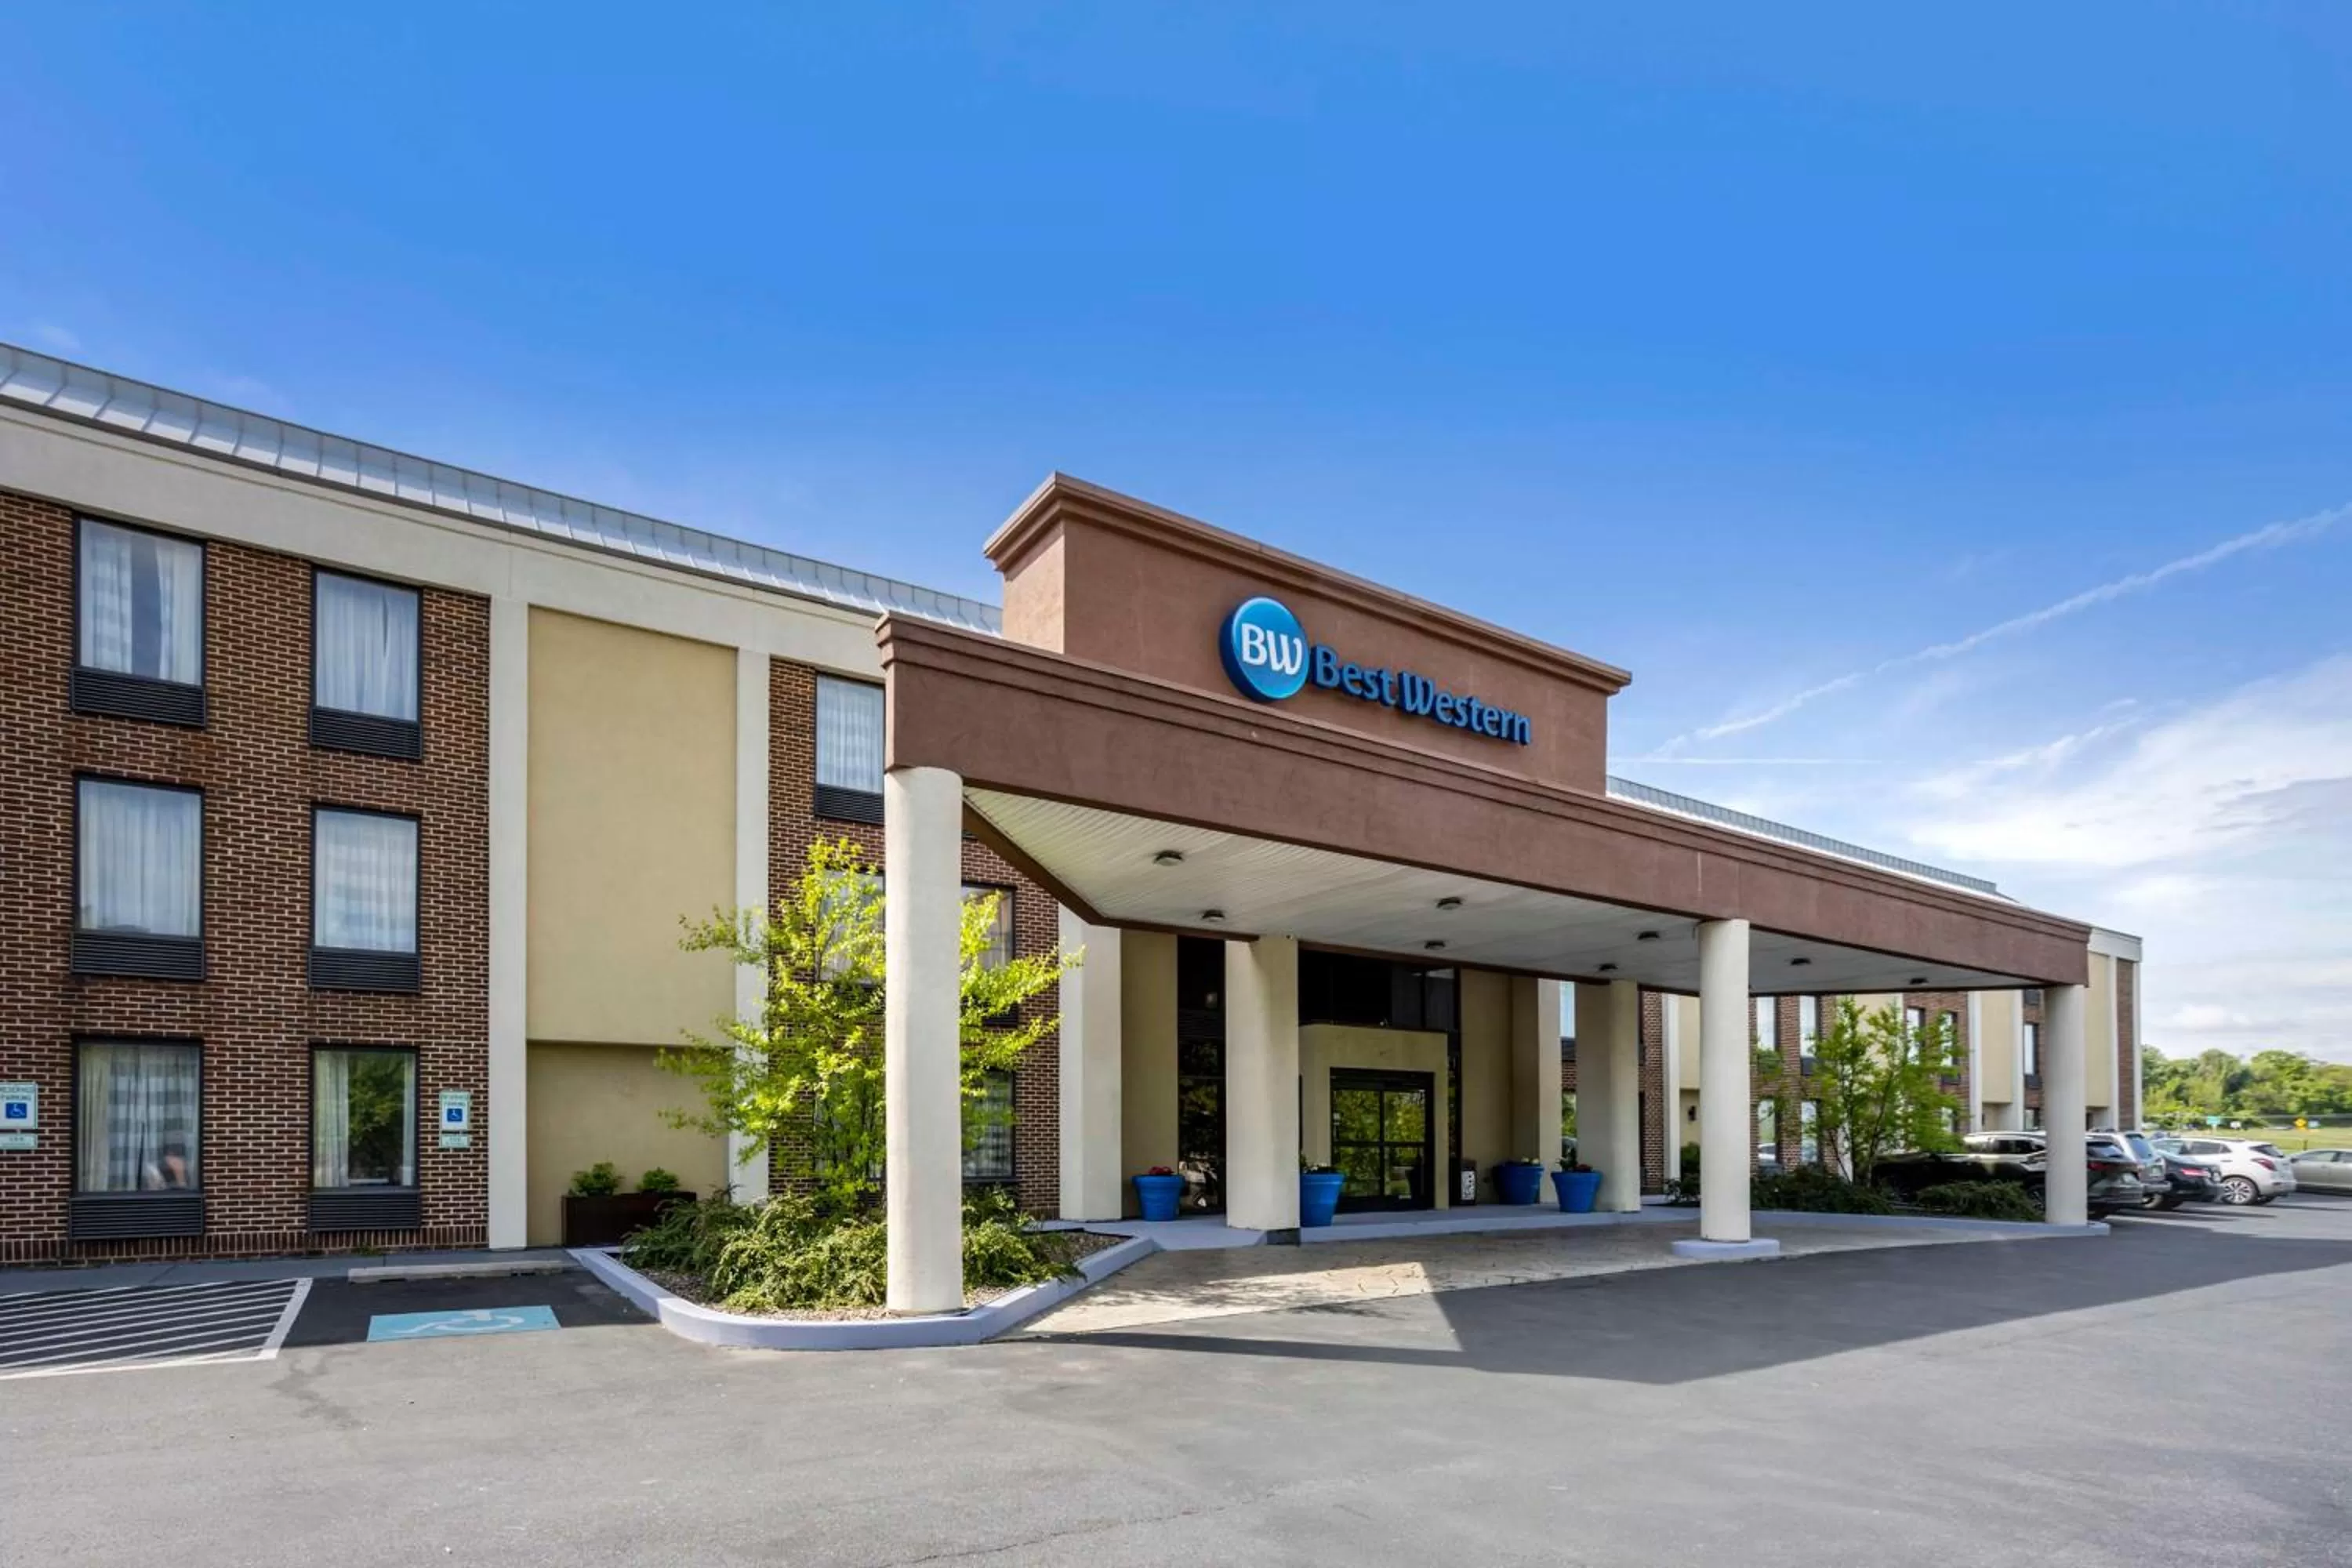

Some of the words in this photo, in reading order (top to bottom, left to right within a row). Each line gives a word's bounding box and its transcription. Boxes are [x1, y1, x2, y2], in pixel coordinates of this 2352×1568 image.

[1241, 623, 1303, 675] BW
[1313, 644, 1396, 707] Best
[1398, 671, 1531, 745] Western
